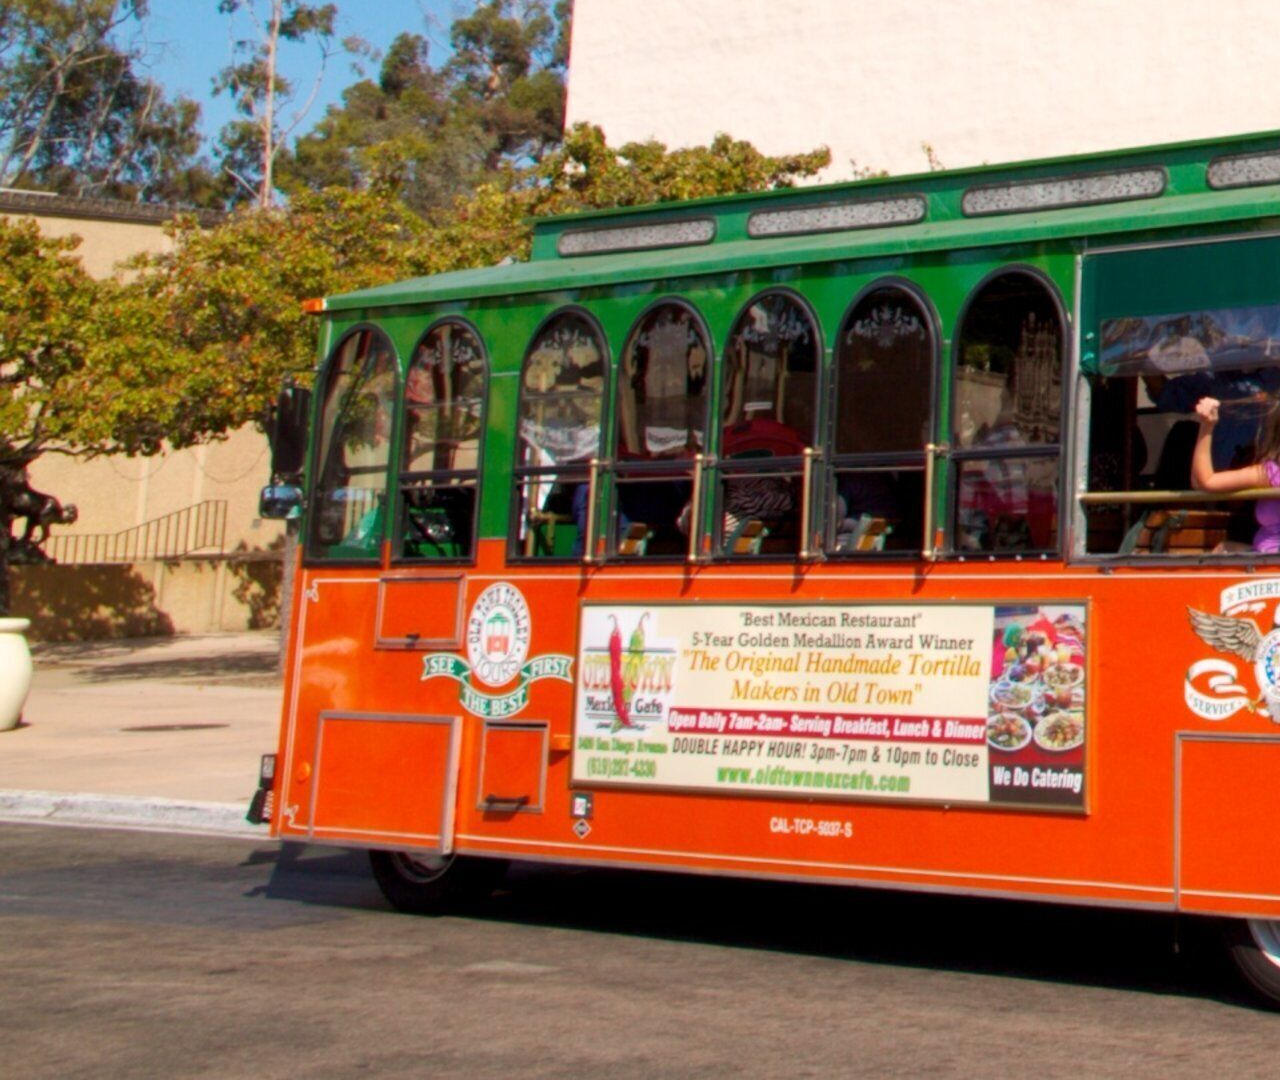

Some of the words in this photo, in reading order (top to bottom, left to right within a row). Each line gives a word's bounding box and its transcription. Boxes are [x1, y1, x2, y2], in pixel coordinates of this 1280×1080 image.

[740, 612, 777, 627] "Best
[779, 612, 837, 627] Mexican
[841, 612, 923, 628] Restaurant"
[691, 632, 734, 648] 5-Year
[738, 632, 790, 648] Golden
[793, 632, 862, 649] Medallion
[866, 634, 914, 650] Award
[918, 634, 975, 651] Winner
[429, 657, 456, 671] SEE
[531, 657, 568, 672] FIRST
[682, 650, 720, 672] "The
[725, 651, 801, 676] Original
[806, 652, 902, 675] Handmade
[908, 654, 982, 677] Tortilla
[463, 689, 490, 715] THE
[490, 689, 526, 716] BEST
[585, 696, 632, 713] Mexicn
[635, 698, 664, 715] Cafe
[730, 679, 799, 703] Makers
[803, 681, 822, 703] in
[826, 681, 860, 705] Old
[864, 682, 923, 706] Town"
[1192, 697, 1236, 716] SERVICE
[669, 711, 696, 730] Open
[699, 712, 726, 733] Daily
[790, 714, 831, 737] Serving
[833, 716, 891, 739] Breakfast,
[893, 718, 930, 738] Lunch
[932, 720, 942, 738] &
[944, 721, 987, 741] Dinner
[671, 737, 718, 756] DOUBLE
[722, 738, 764, 758] HAPPY
[767, 740, 808, 759] HOUR!
[810, 743, 868, 765] 3pm-7pm
[870, 746, 881, 763] &
[885, 746, 922, 768] 10pm
[925, 748, 939, 765] to
[941, 748, 980, 768] Close
[716, 764, 912, 793] www.oldtownmexcafe.com
[993, 766, 1012, 786] We
[1013, 767, 1029, 788] Do
[1031, 767, 1083, 794] Catering
